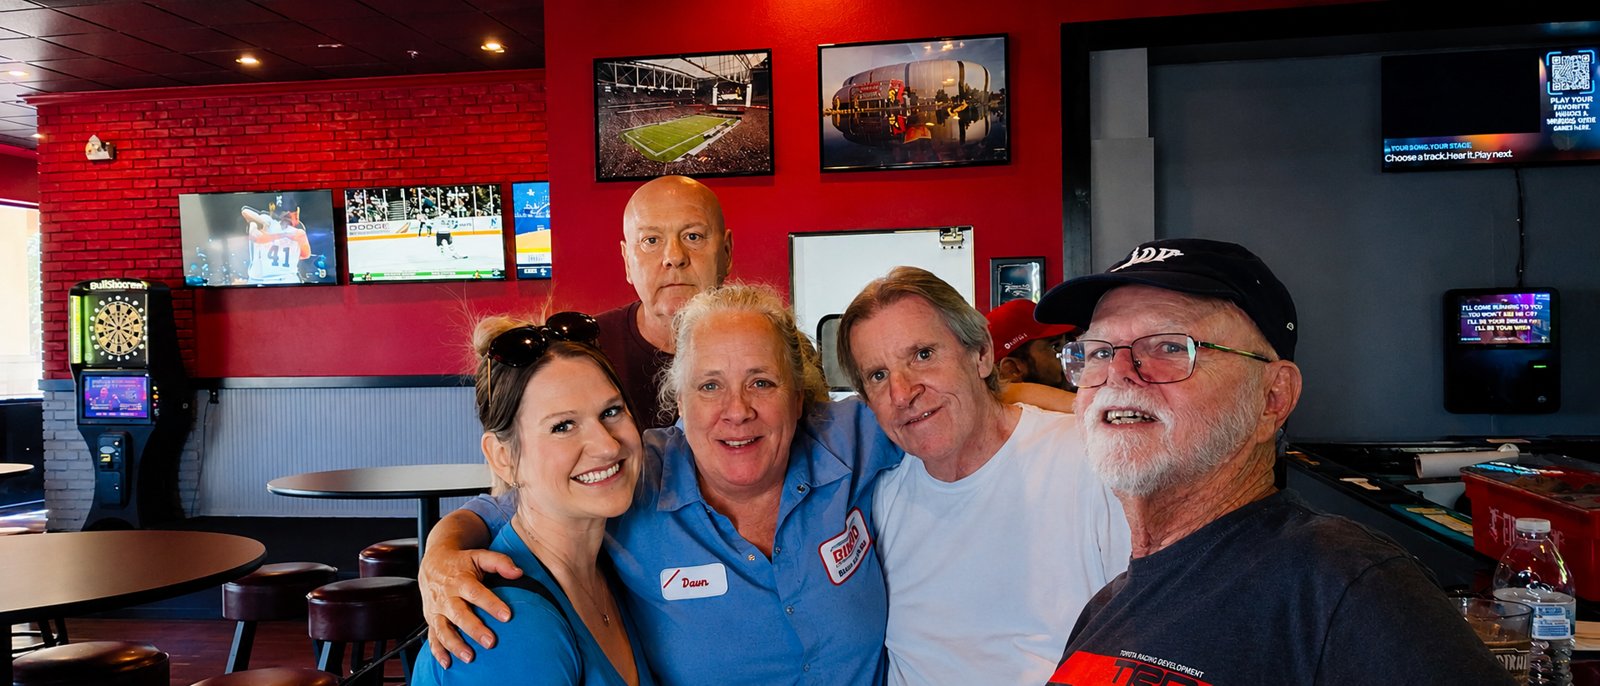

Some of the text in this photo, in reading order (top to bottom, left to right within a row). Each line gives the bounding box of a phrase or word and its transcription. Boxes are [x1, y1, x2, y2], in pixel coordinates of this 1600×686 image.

[1553, 103, 1590, 111] FAVORITE
[1384, 153, 1417, 162] Choose
[349, 223, 389, 231] DODGE
[267, 245, 291, 267] 41
[1120, 650, 1205, 679] TOYOTA RACING DEVELOPMENT
